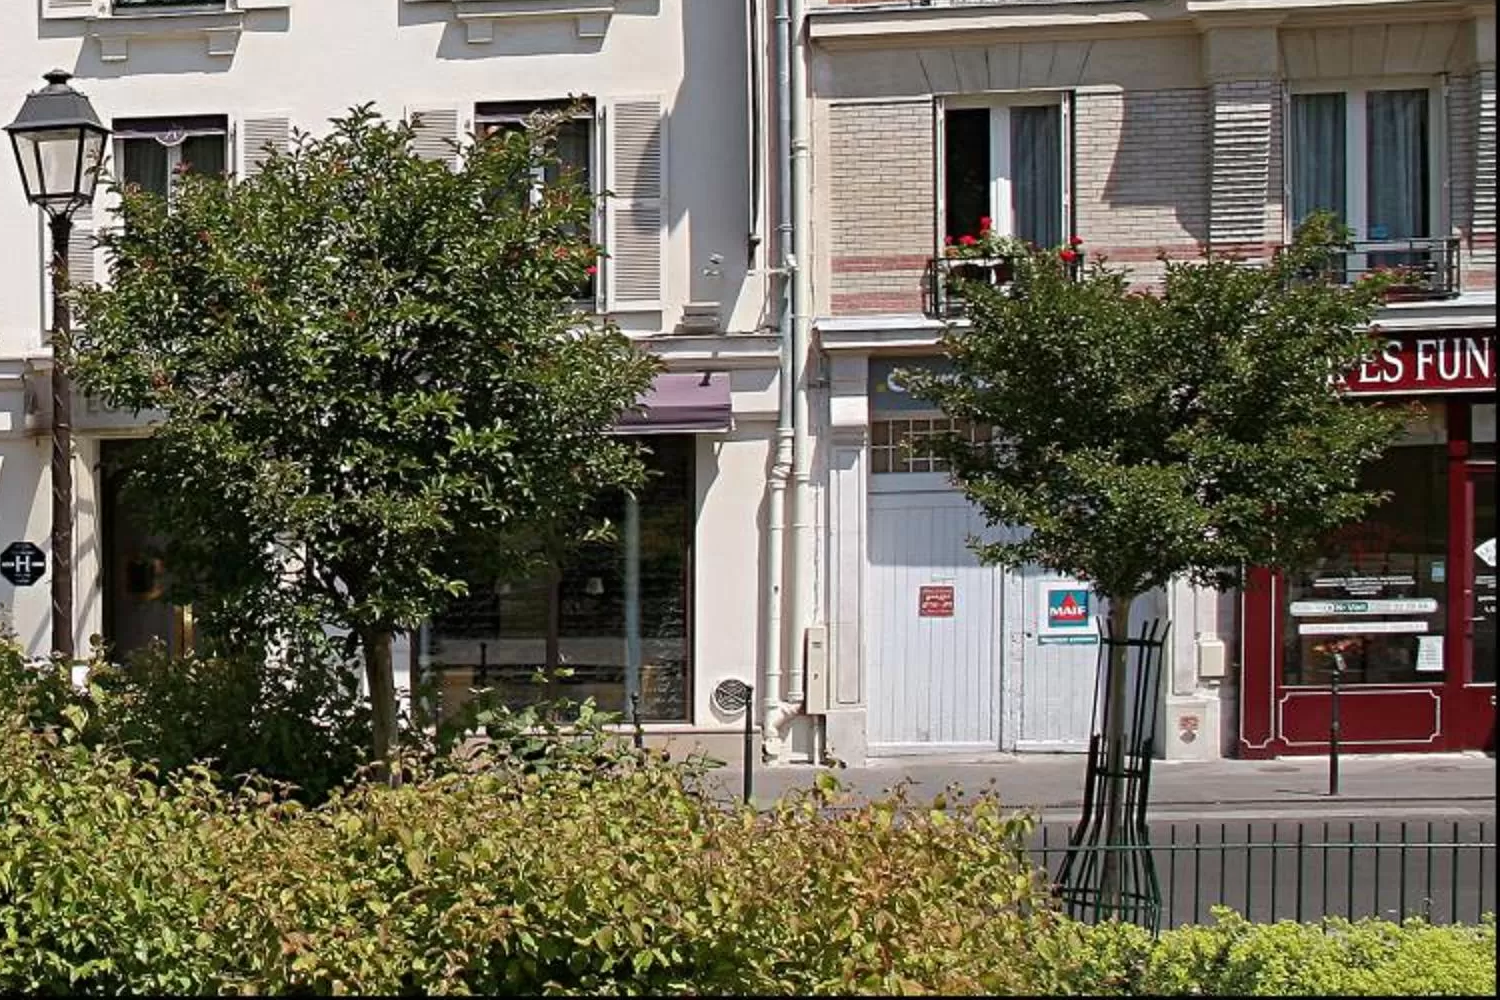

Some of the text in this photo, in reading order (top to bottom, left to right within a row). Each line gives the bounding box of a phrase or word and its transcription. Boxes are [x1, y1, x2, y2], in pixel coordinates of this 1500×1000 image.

[1415, 336, 1496, 381] FUN
[15, 555, 31, 573] H
[1049, 605, 1087, 617] MAIF
